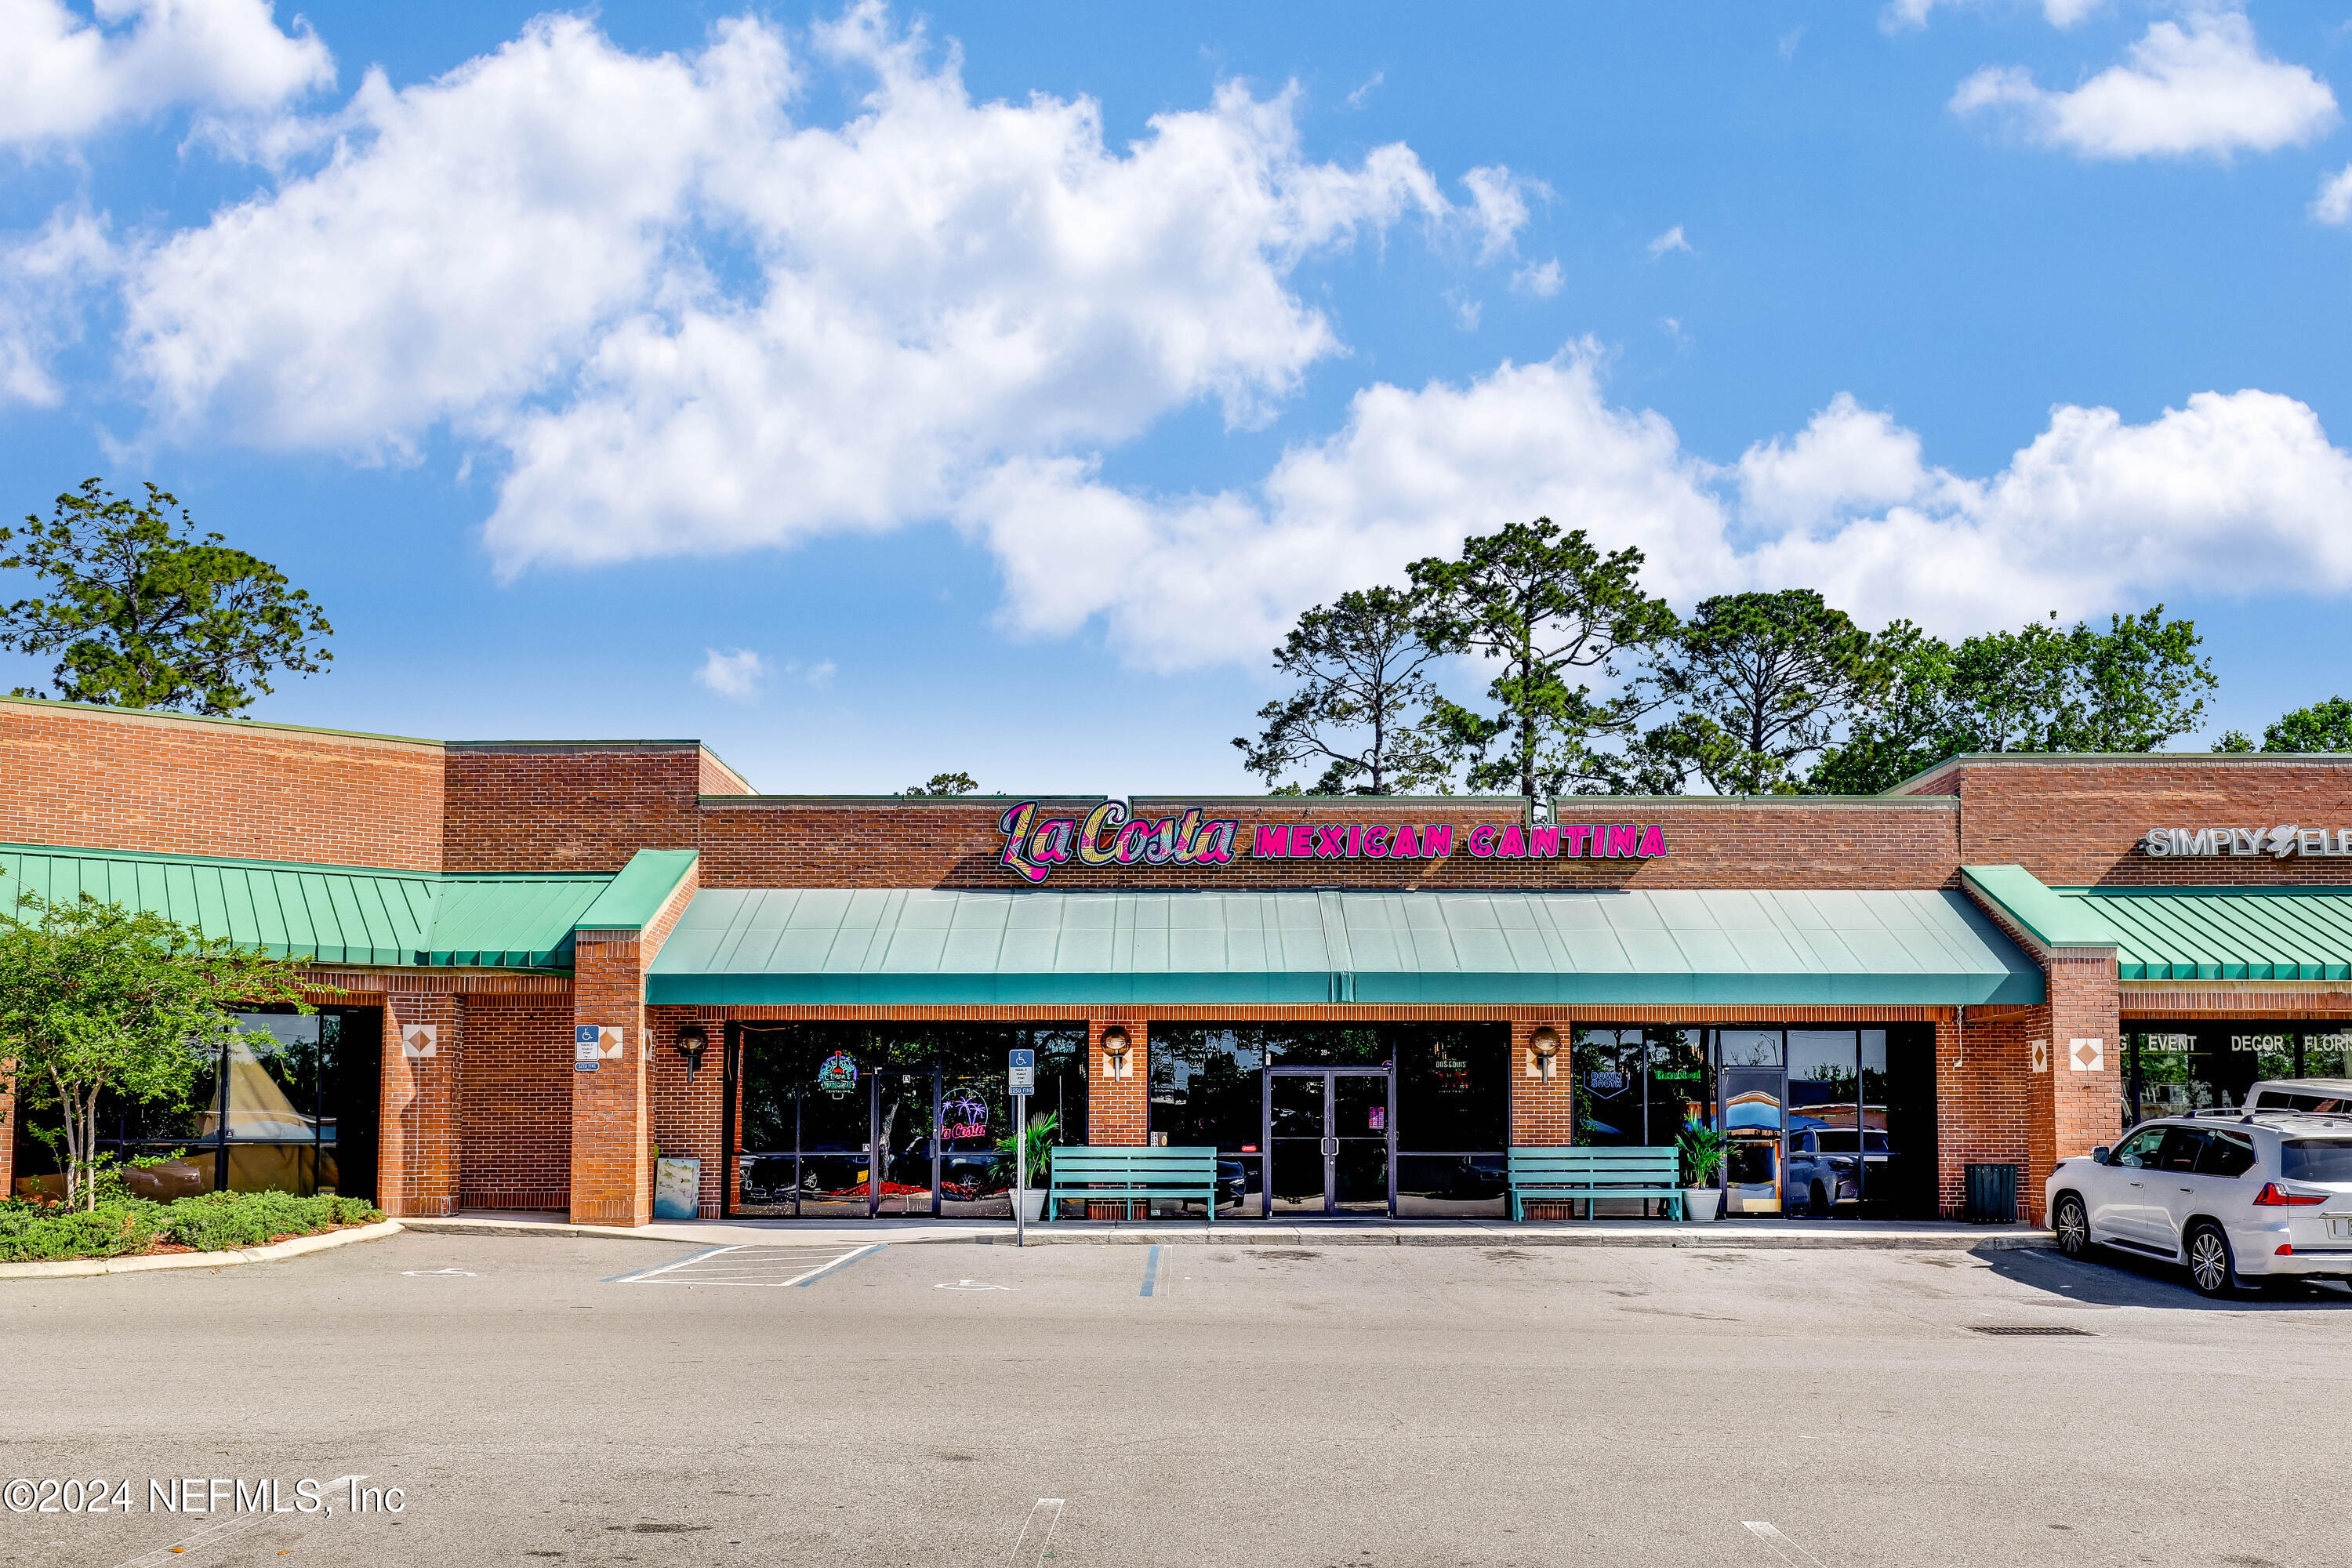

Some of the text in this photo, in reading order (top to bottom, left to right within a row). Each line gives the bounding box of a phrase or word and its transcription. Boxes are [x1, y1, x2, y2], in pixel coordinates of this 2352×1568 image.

[1000, 799, 1241, 884] La Costa
[1253, 822, 1668, 860] MEXICAN CANTINA
[2146, 827, 2268, 856] SIMPLY
[2148, 1035, 2197, 1051] EVENT
[2230, 1035, 2285, 1051] DECOR
[1591, 1072, 1622, 1080] DOWN
[1591, 1080, 1622, 1088] SOUTH
[952, 1123, 987, 1139] Costa
